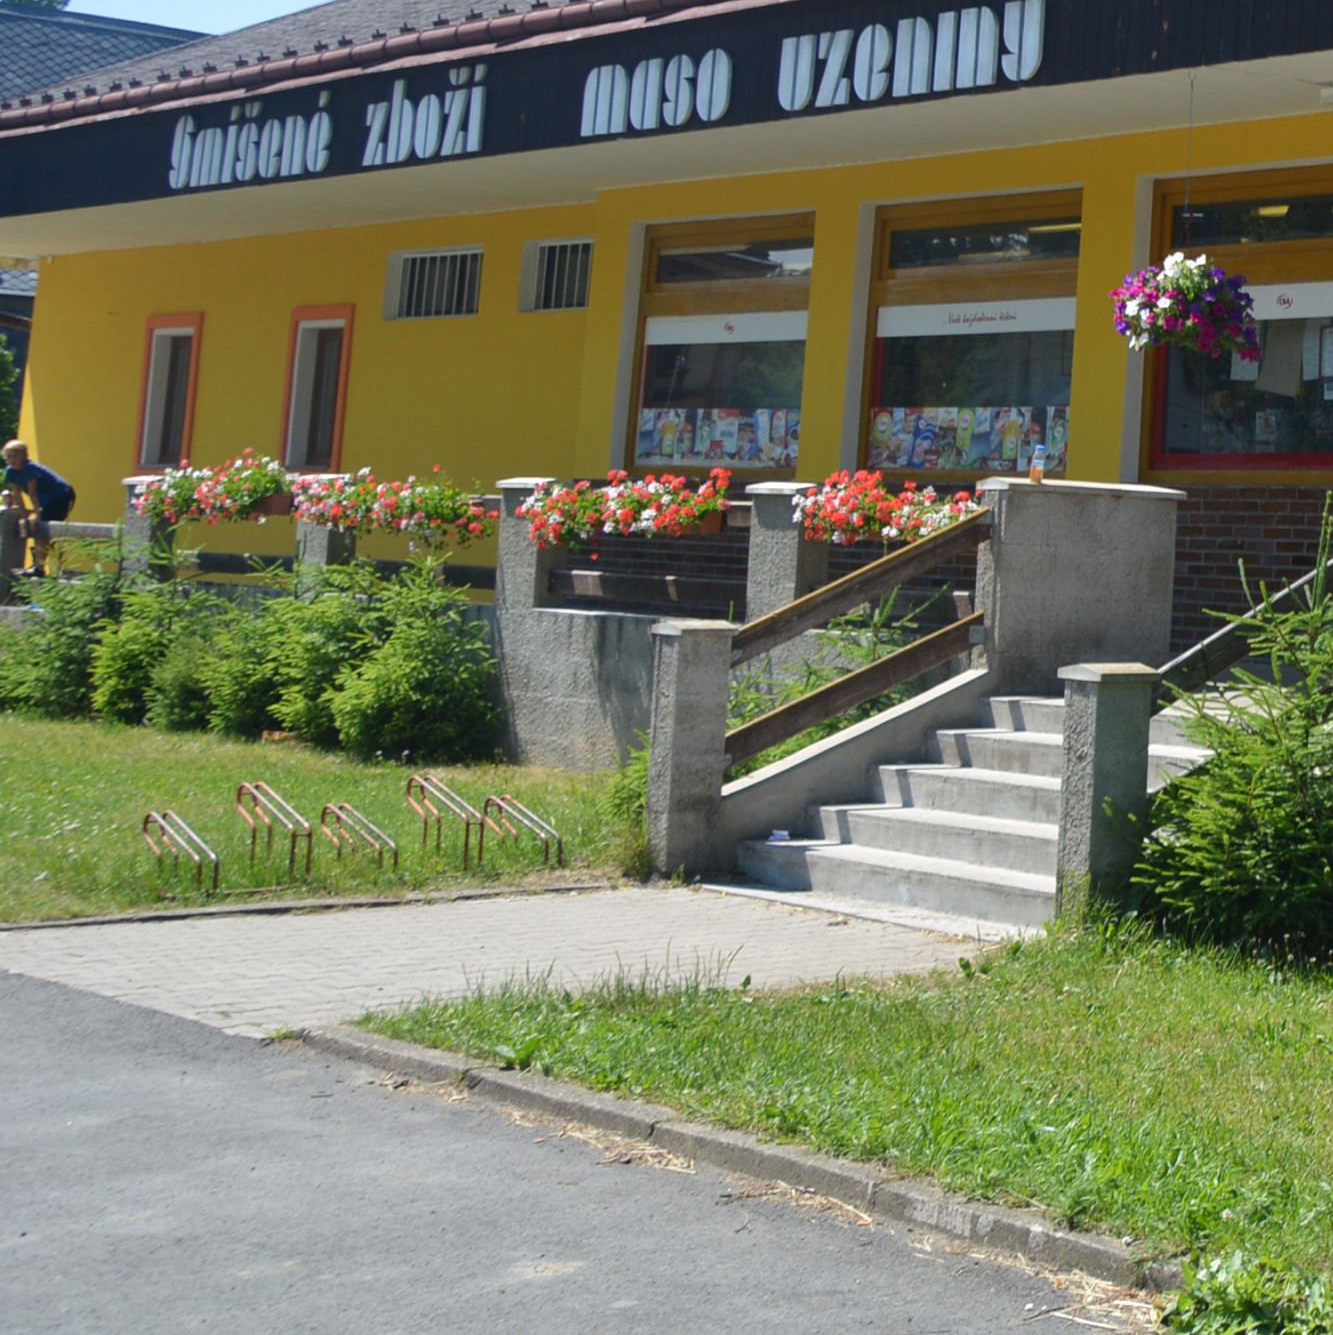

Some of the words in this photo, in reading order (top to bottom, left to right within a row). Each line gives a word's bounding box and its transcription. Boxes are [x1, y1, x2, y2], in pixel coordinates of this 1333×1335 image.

[168, 89, 334, 190] Smíšené
[361, 63, 487, 167] zboží
[579, 47, 733, 138] maso
